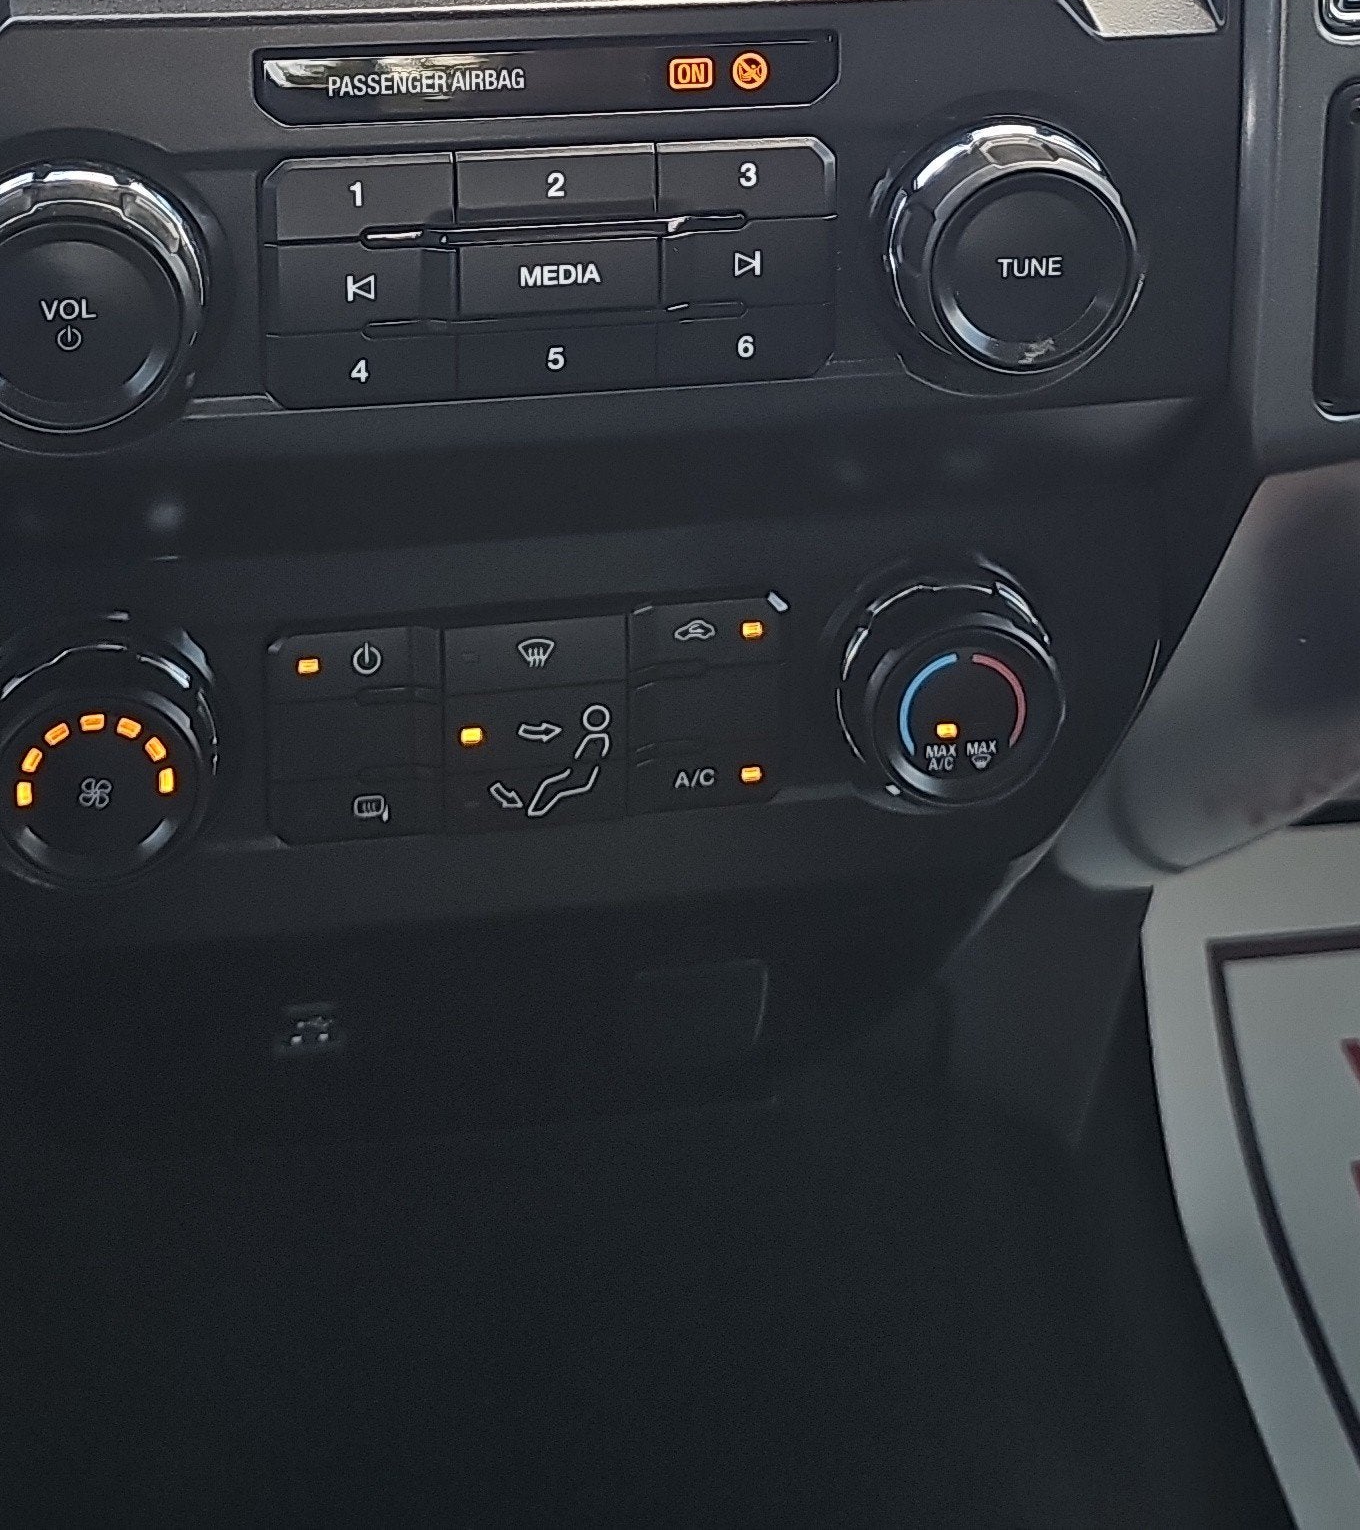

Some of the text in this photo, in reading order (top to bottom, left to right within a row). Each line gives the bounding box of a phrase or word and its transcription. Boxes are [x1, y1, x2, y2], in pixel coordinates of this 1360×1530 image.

[328, 68, 525, 97] PASSENGER AIRBAG
[677, 64, 705, 84] ON
[548, 171, 566, 197] 2
[740, 163, 756, 186] 3
[349, 182, 361, 206] 1
[521, 264, 600, 286] MEDIA
[998, 257, 1062, 277] TUNE
[41, 299, 96, 320] VOL
[738, 336, 753, 357] 6
[548, 347, 564, 369] 5
[351, 360, 368, 382] 4
[926, 744, 957, 758] MAX
[967, 740, 996, 755] MAX
[927, 757, 954, 771] A/C
[675, 769, 714, 788] A/C
